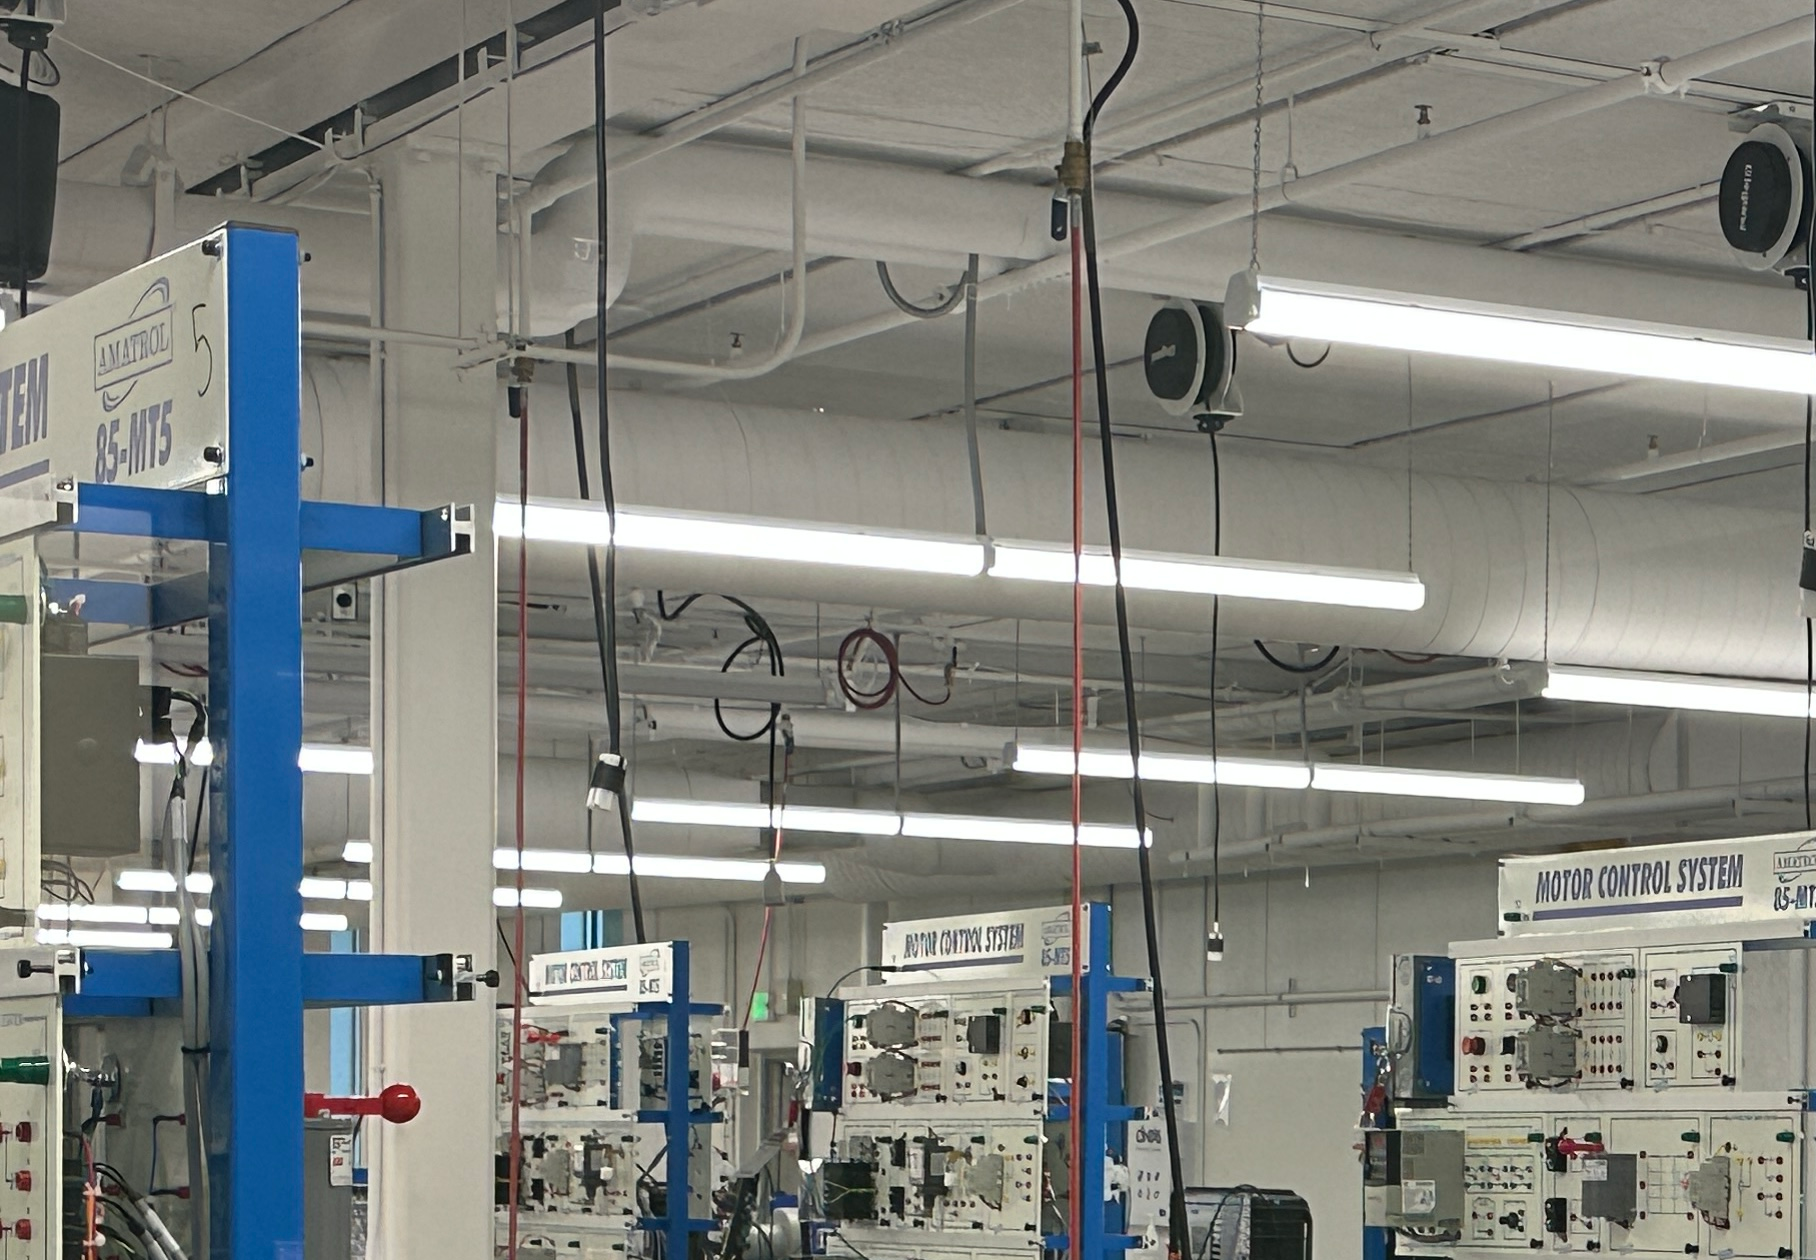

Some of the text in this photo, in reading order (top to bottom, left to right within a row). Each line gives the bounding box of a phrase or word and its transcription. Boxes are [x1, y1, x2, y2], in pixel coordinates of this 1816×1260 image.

[97, 322, 170, 376] AMATROL
[192, 303, 213, 397] 5
[95, 399, 173, 483] 85-MT5
[1535, 854, 1744, 904] MOTOR CONTROL SYSTEM
